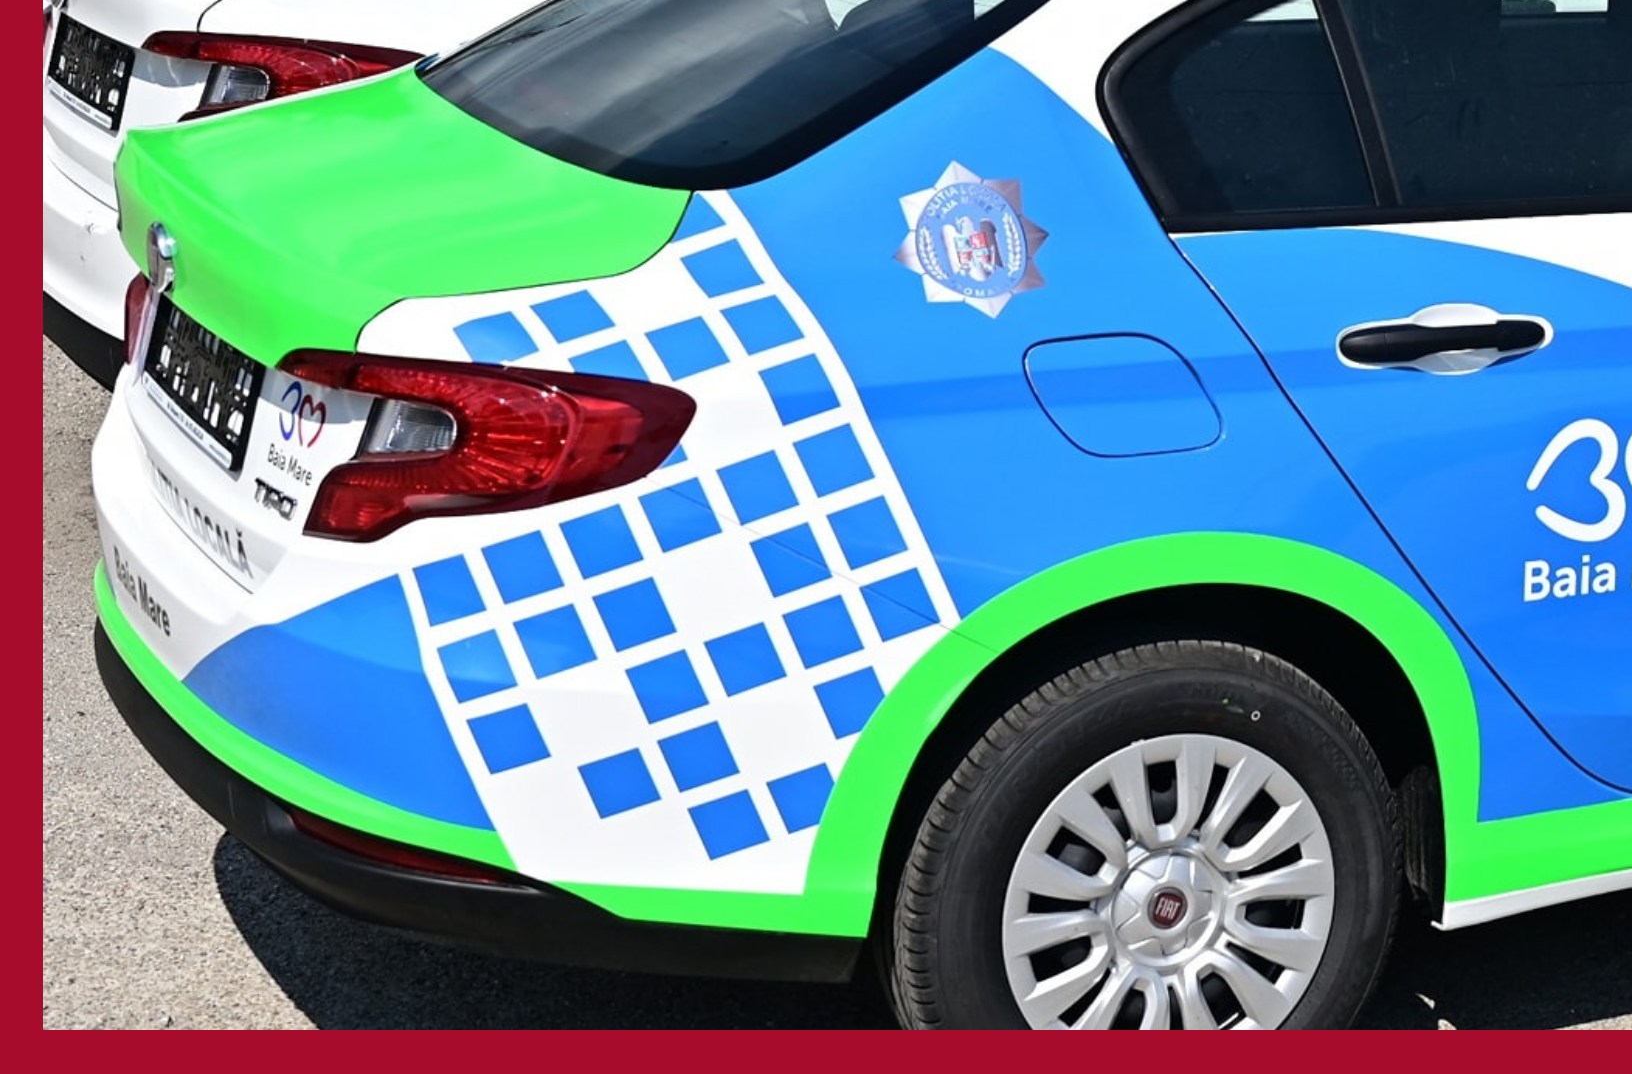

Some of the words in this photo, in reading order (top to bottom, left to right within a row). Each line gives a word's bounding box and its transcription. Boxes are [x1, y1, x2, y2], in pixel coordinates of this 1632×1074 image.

[267, 443, 286, 471] Baia
[287, 455, 313, 486] Mare
[114, 545, 138, 603] Baia
[138, 575, 171, 637] Mare
[1523, 554, 1617, 603] Baia
[1155, 896, 1181, 920] FIAT
